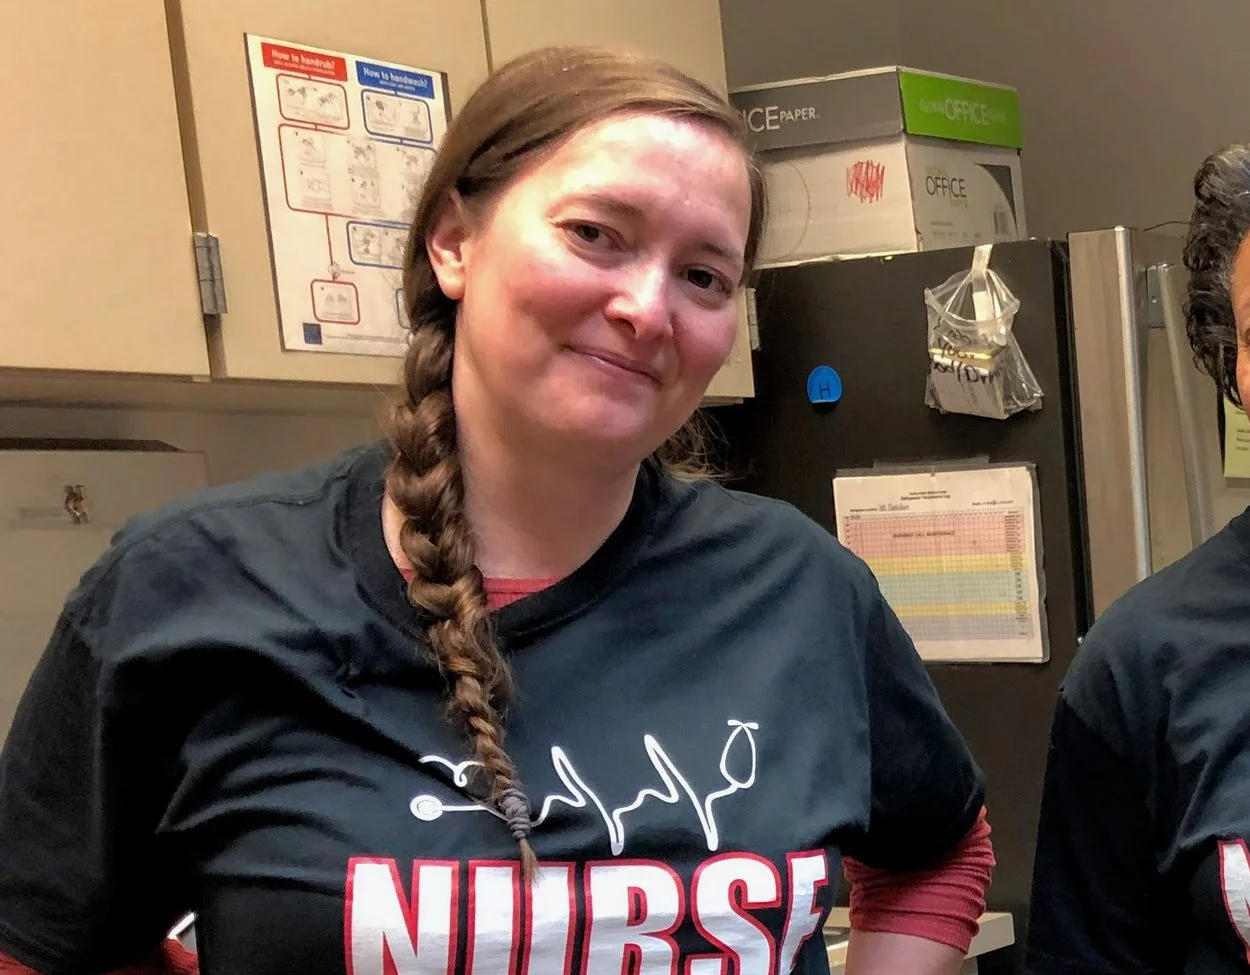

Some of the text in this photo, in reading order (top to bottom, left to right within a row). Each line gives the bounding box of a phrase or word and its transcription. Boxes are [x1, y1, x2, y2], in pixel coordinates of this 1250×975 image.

[271, 48, 290, 60] How
[291, 53, 300, 63] to
[363, 67, 380, 78] How
[381, 71, 390, 80] to
[390, 72, 428, 88] handwash?
[780, 107, 816, 122] PAPER
[925, 175, 967, 198] OFFICE
